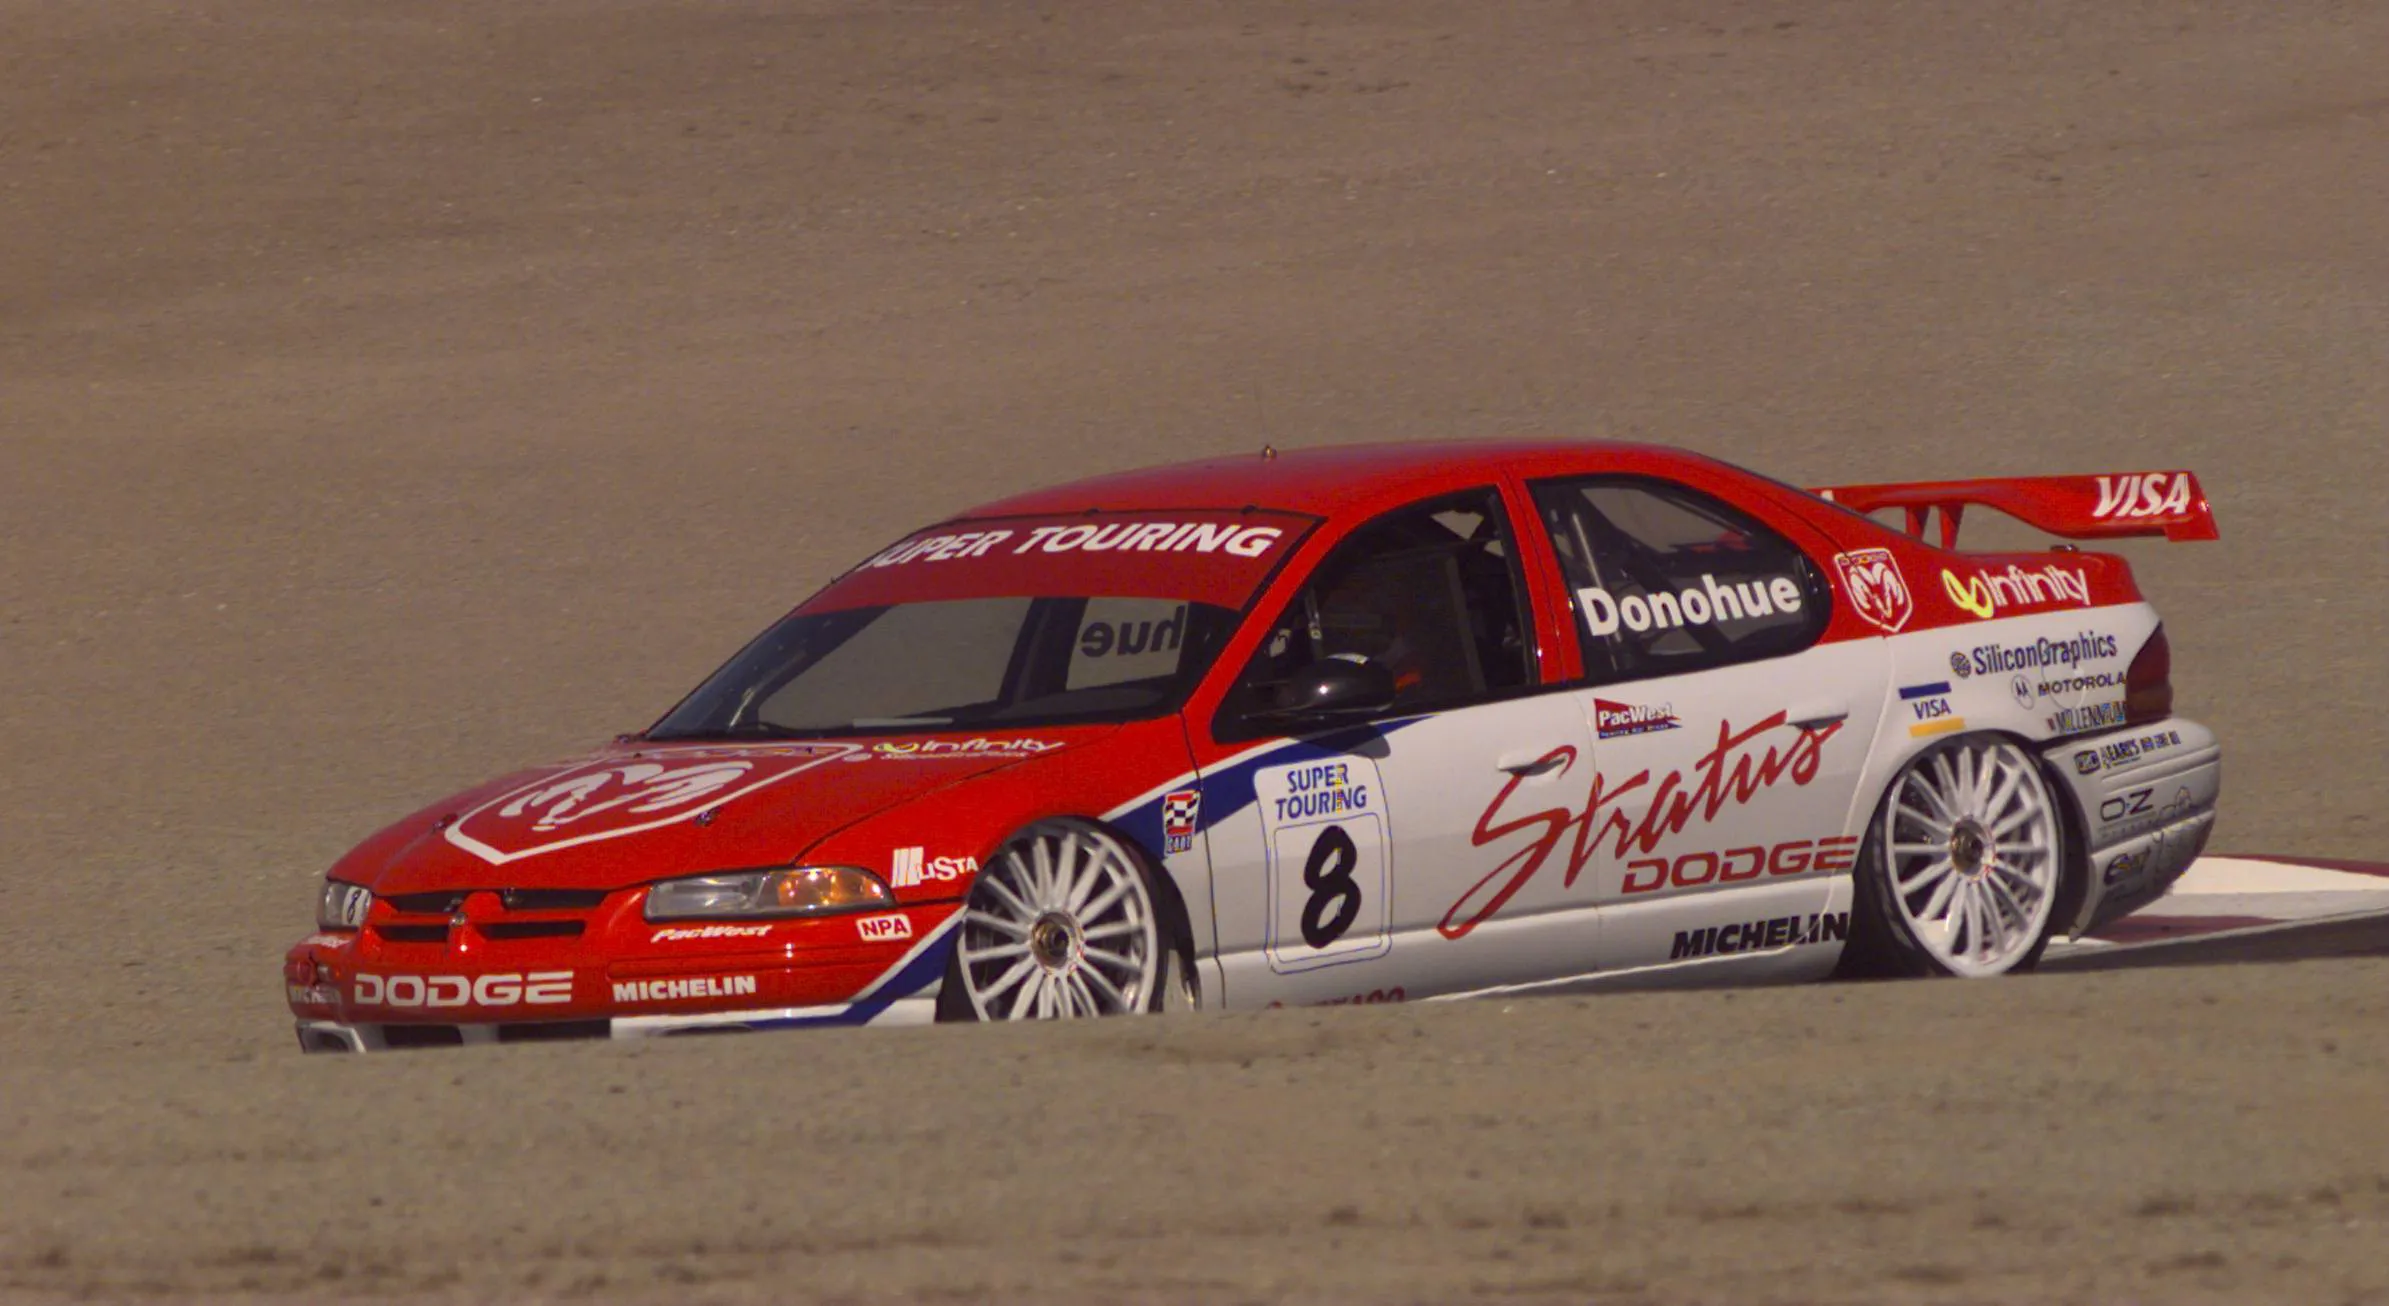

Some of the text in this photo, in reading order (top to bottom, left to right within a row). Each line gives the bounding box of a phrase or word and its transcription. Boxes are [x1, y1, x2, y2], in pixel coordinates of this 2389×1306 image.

[2093, 474, 2191, 518] VISA
[1012, 522, 1282, 557] TOURING
[1577, 574, 1801, 637] Donohue
[2037, 671, 2126, 697] MOTOROLA
[1599, 702, 1673, 727] PacWest
[1914, 699, 1952, 720] VISA
[1287, 763, 1349, 793] SUPER
[1275, 785, 1367, 821] TOURING
[1437, 709, 1844, 940] Stratus
[1621, 836, 1858, 893] DODGE
[1301, 825, 1362, 949] 8
[861, 917, 908, 936] NPA
[1670, 912, 1848, 960] MICHELIN
[354, 971, 574, 1007] DODGE
[613, 975, 756, 1003] MICHELIN
